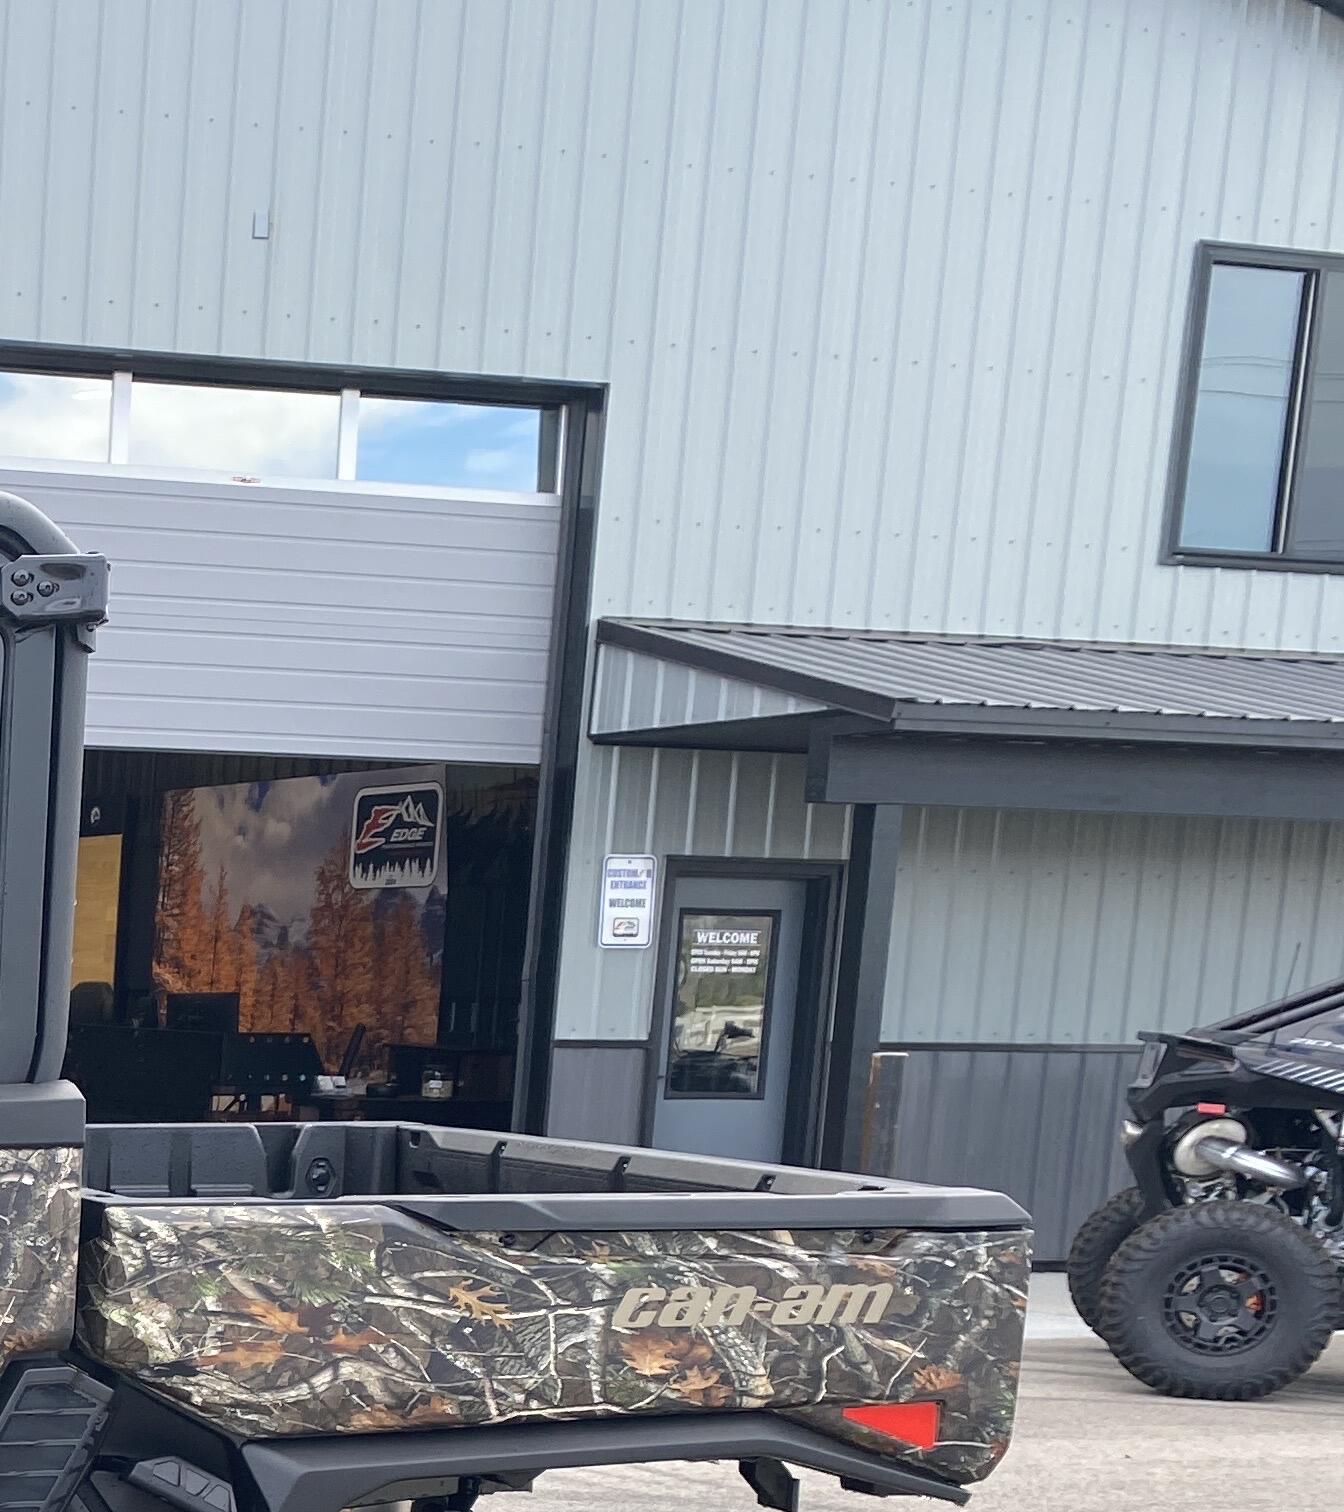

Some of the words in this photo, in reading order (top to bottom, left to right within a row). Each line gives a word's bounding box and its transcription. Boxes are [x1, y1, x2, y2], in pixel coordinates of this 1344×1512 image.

[390, 827, 427, 842] EDGE
[607, 868, 652, 878] CUSTOMR
[610, 880, 647, 889] ENTRANCE
[609, 898, 646, 908] WELCOME
[697, 931, 759, 944] WELCOME
